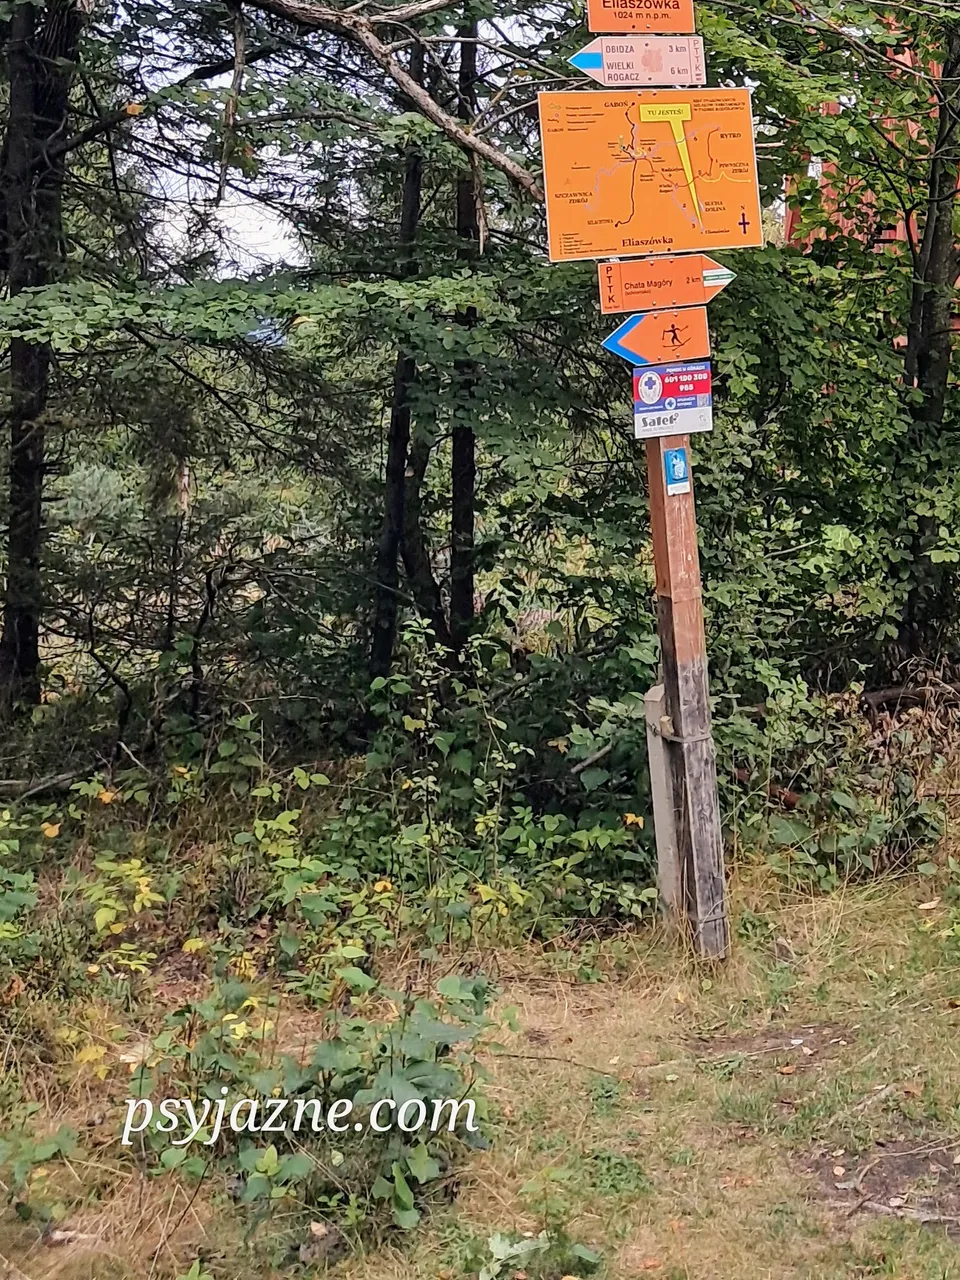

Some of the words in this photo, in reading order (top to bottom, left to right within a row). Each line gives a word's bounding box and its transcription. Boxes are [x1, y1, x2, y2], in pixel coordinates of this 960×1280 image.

[613, 11, 633, 19] 1024
[646, 12, 672, 20] n.p.m.
[605, 45, 635, 54] OBIDZA
[668, 45, 674, 53] 3
[675, 44, 687, 53] km
[606, 62, 634, 70] WIELKI
[670, 67, 676, 75] 6
[677, 67, 689, 75] km
[607, 73, 640, 81] ROGACZ
[622, 236, 674, 247] Eliaszówka
[686, 276, 690, 284] 2
[624, 281, 645, 291] Chata
[646, 279, 673, 289] Magóry
[664, 375, 678, 383] 601
[679, 374, 692, 382] 100
[693, 372, 708, 380] 300
